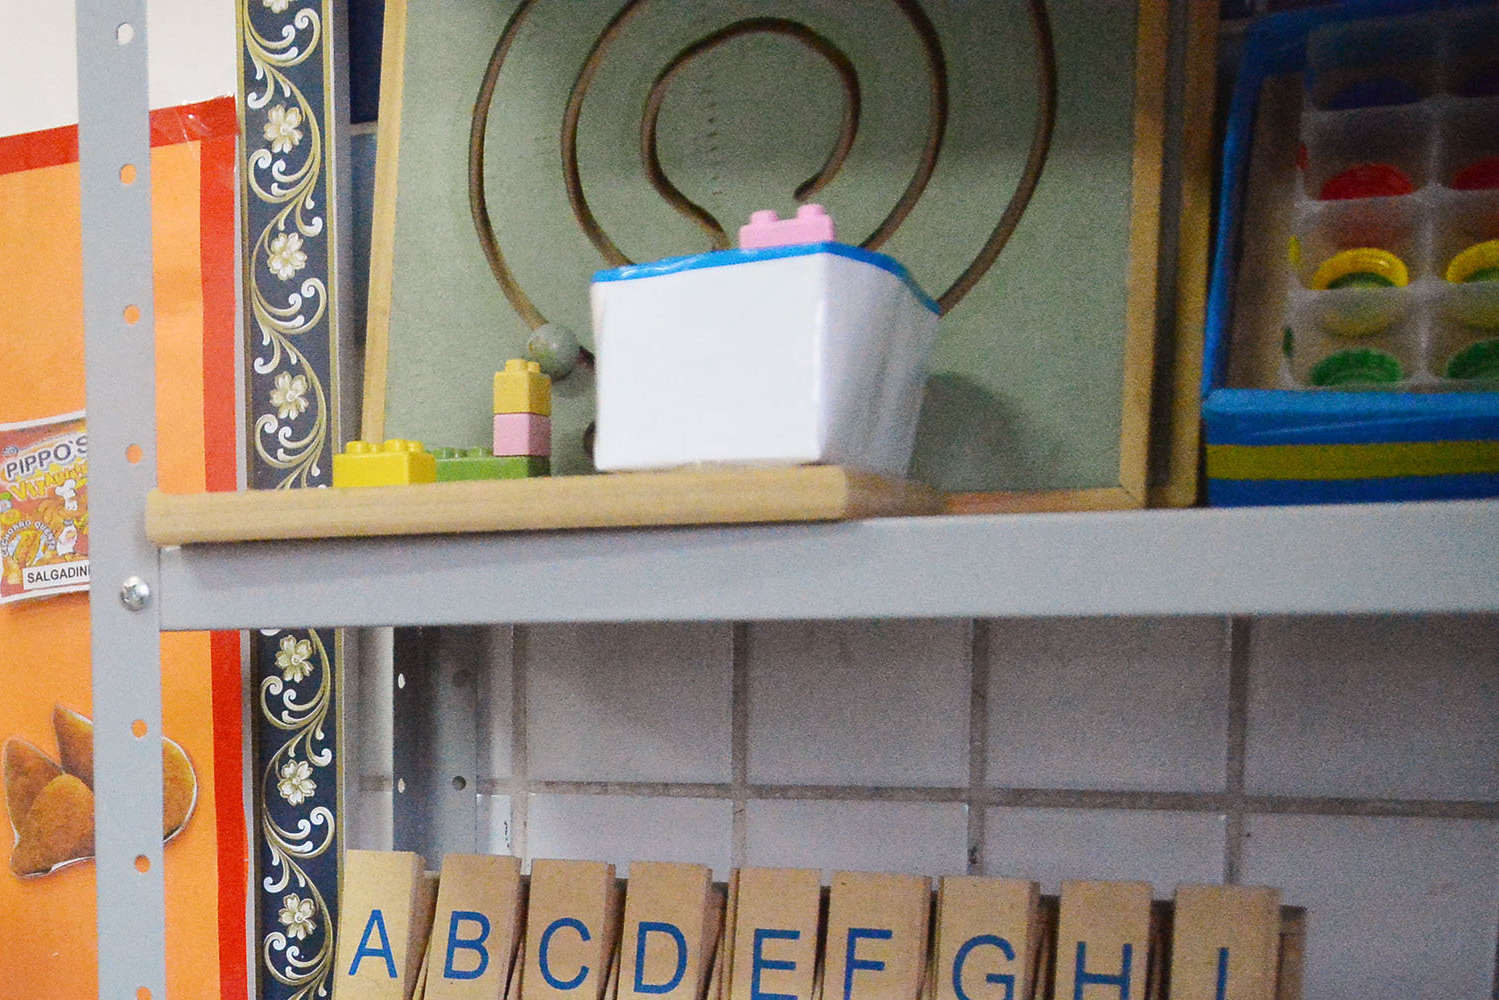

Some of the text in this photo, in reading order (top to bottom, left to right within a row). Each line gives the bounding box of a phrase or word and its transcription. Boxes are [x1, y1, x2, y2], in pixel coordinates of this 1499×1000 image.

[27, 564, 91, 584] SALGADIN
[349, 910, 397, 977] A
[444, 911, 490, 979] B
[540, 918, 590, 989] C
[635, 922, 686, 993] D
[844, 928, 892, 1000] F
